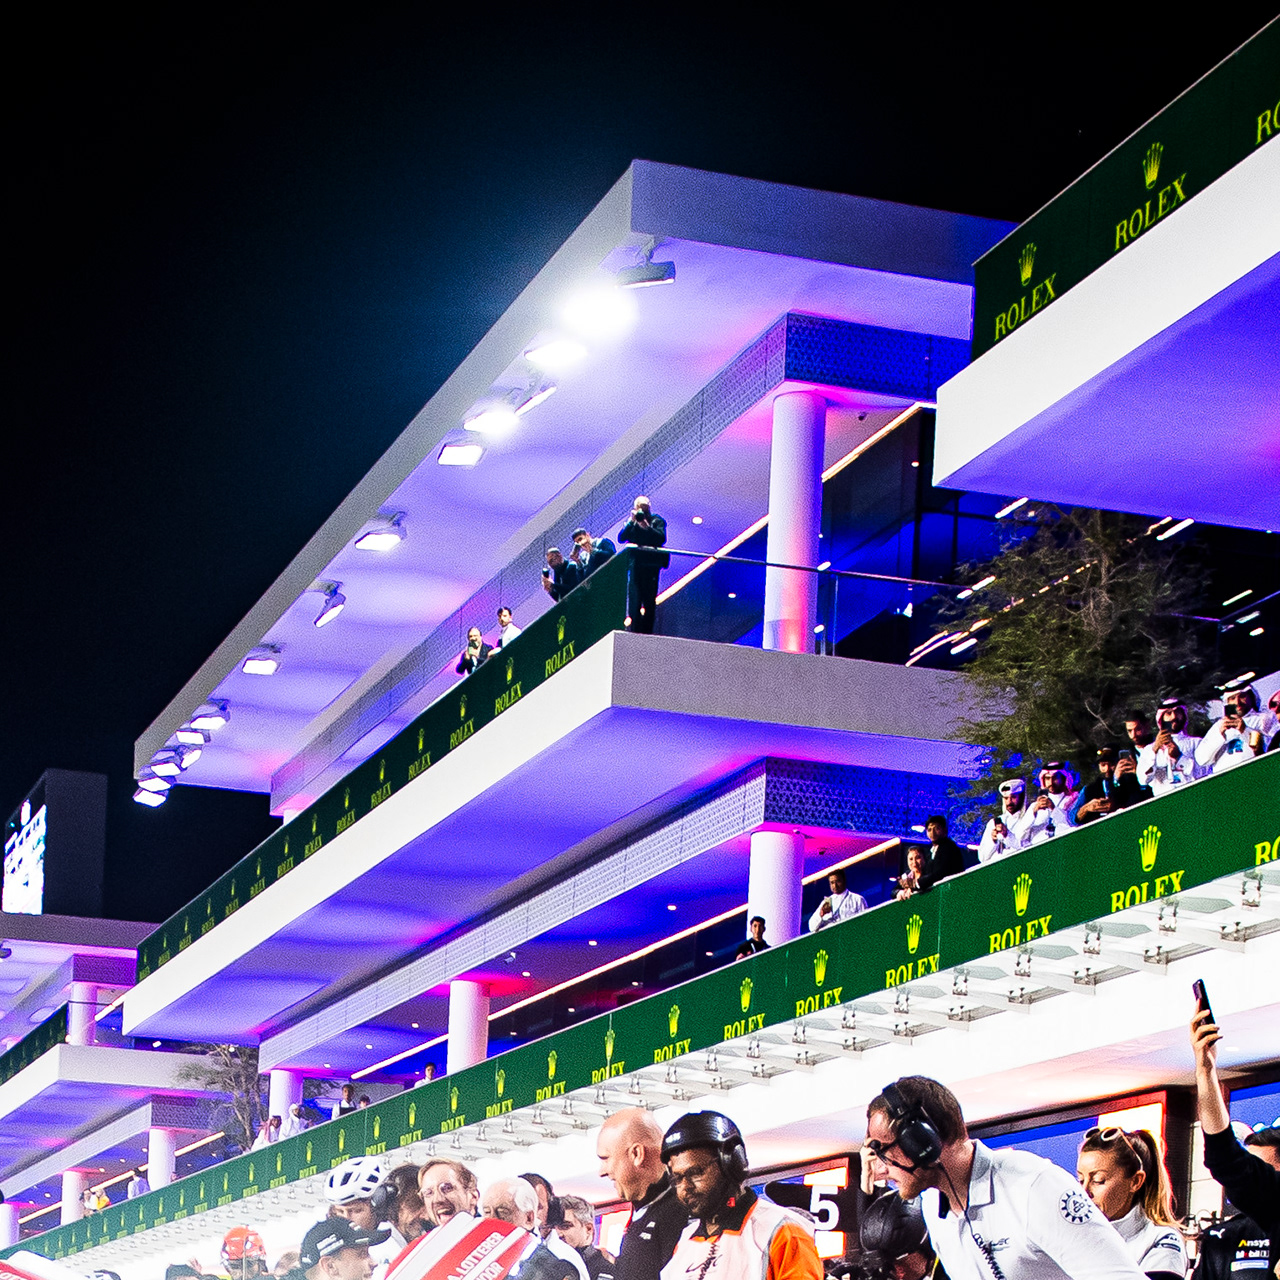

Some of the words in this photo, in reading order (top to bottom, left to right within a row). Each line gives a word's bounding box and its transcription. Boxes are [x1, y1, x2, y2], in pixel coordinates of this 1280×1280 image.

[1114, 173, 1186, 252] ROLEX
[994, 273, 1057, 341] ROLEX
[545, 640, 575, 678] ROLEX
[494, 682, 522, 716] ROLEX
[450, 718, 475, 749] ROLEX
[1110, 869, 1186, 913] ROLEX
[988, 914, 1053, 954] ROLEX
[885, 952, 941, 989] ROLEX
[795, 985, 844, 1018] ROLEX
[723, 1012, 766, 1041] ROLEX
[809, 1185, 840, 1232] 5
[458, 1231, 505, 1277] LOTTERER
[1238, 1239, 1270, 1248] Ansys
